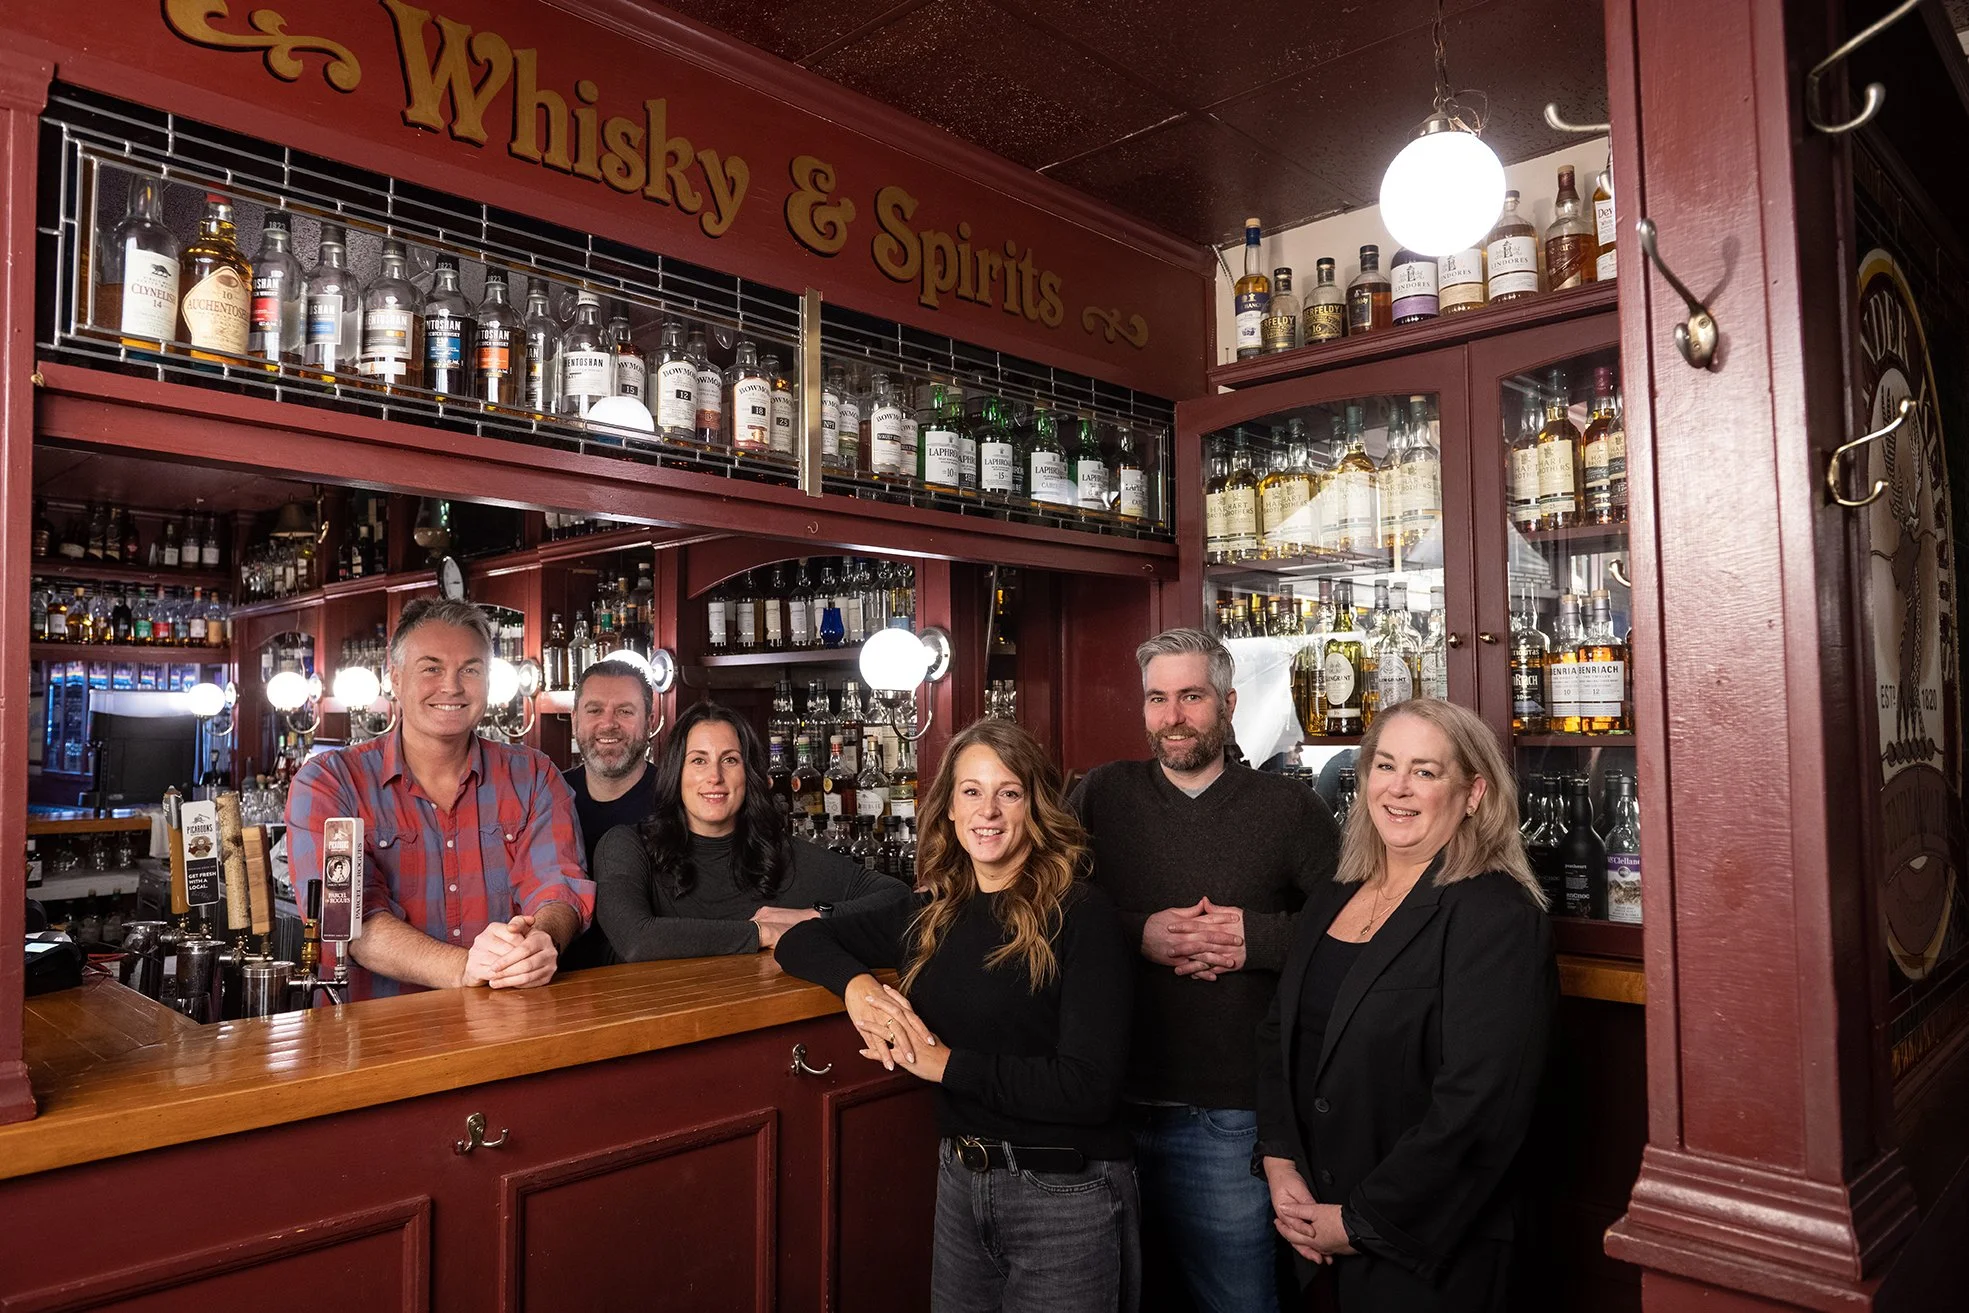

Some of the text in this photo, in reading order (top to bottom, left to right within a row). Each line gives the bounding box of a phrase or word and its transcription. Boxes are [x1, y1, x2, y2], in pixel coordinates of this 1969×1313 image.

[382, 0, 1065, 328] Whisky & Spirits
[268, 220, 286, 231] 1823
[487, 275, 502, 283] 1823
[222, 290, 233, 300] 10
[153, 299, 163, 309] 14
[1312, 323, 1322, 333] 16
[626, 386, 635, 394] 15
[680, 391, 689, 399] 12
[755, 407, 764, 415] 18
[947, 468, 954, 477] 10
[1564, 688, 1571, 696] 10
[1921, 688, 1938, 711] 1820
[187, 824, 213, 835] PICAROONS
